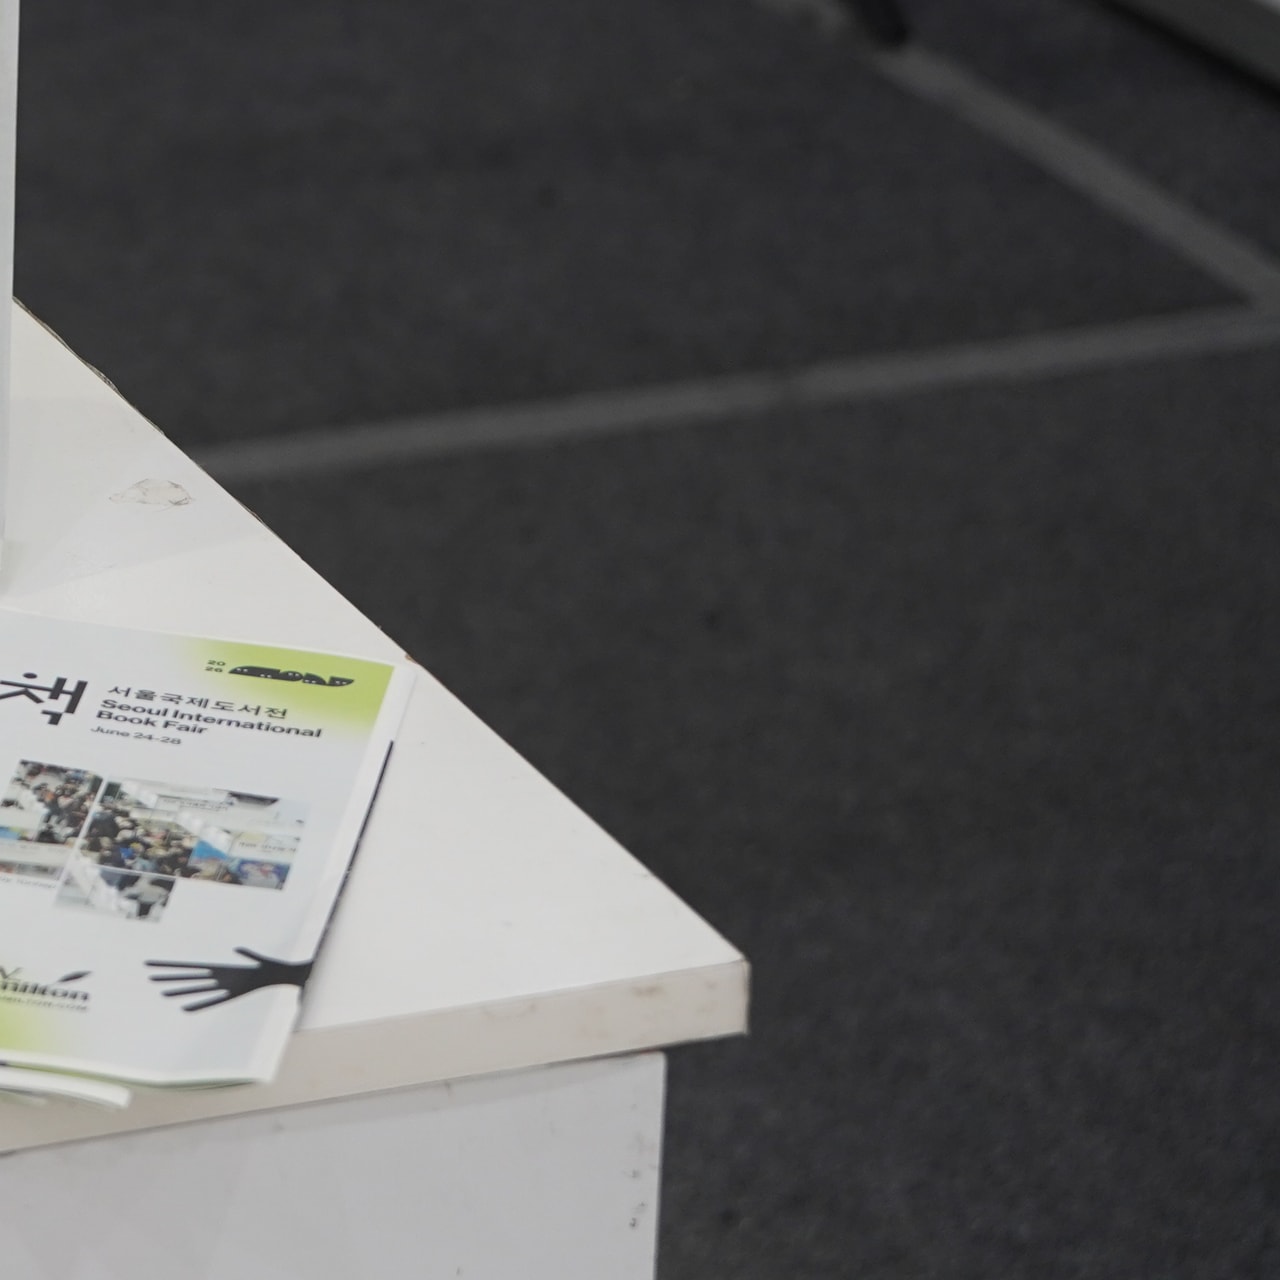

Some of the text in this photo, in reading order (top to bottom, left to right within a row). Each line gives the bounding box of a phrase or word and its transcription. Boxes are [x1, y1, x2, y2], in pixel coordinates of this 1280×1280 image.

[107, 685, 289, 720] 서울국제도서전
[95, 709, 208, 735] Book Fair
[100, 699, 322, 738] Seoul International
[90, 724, 182, 746] June 24-28
